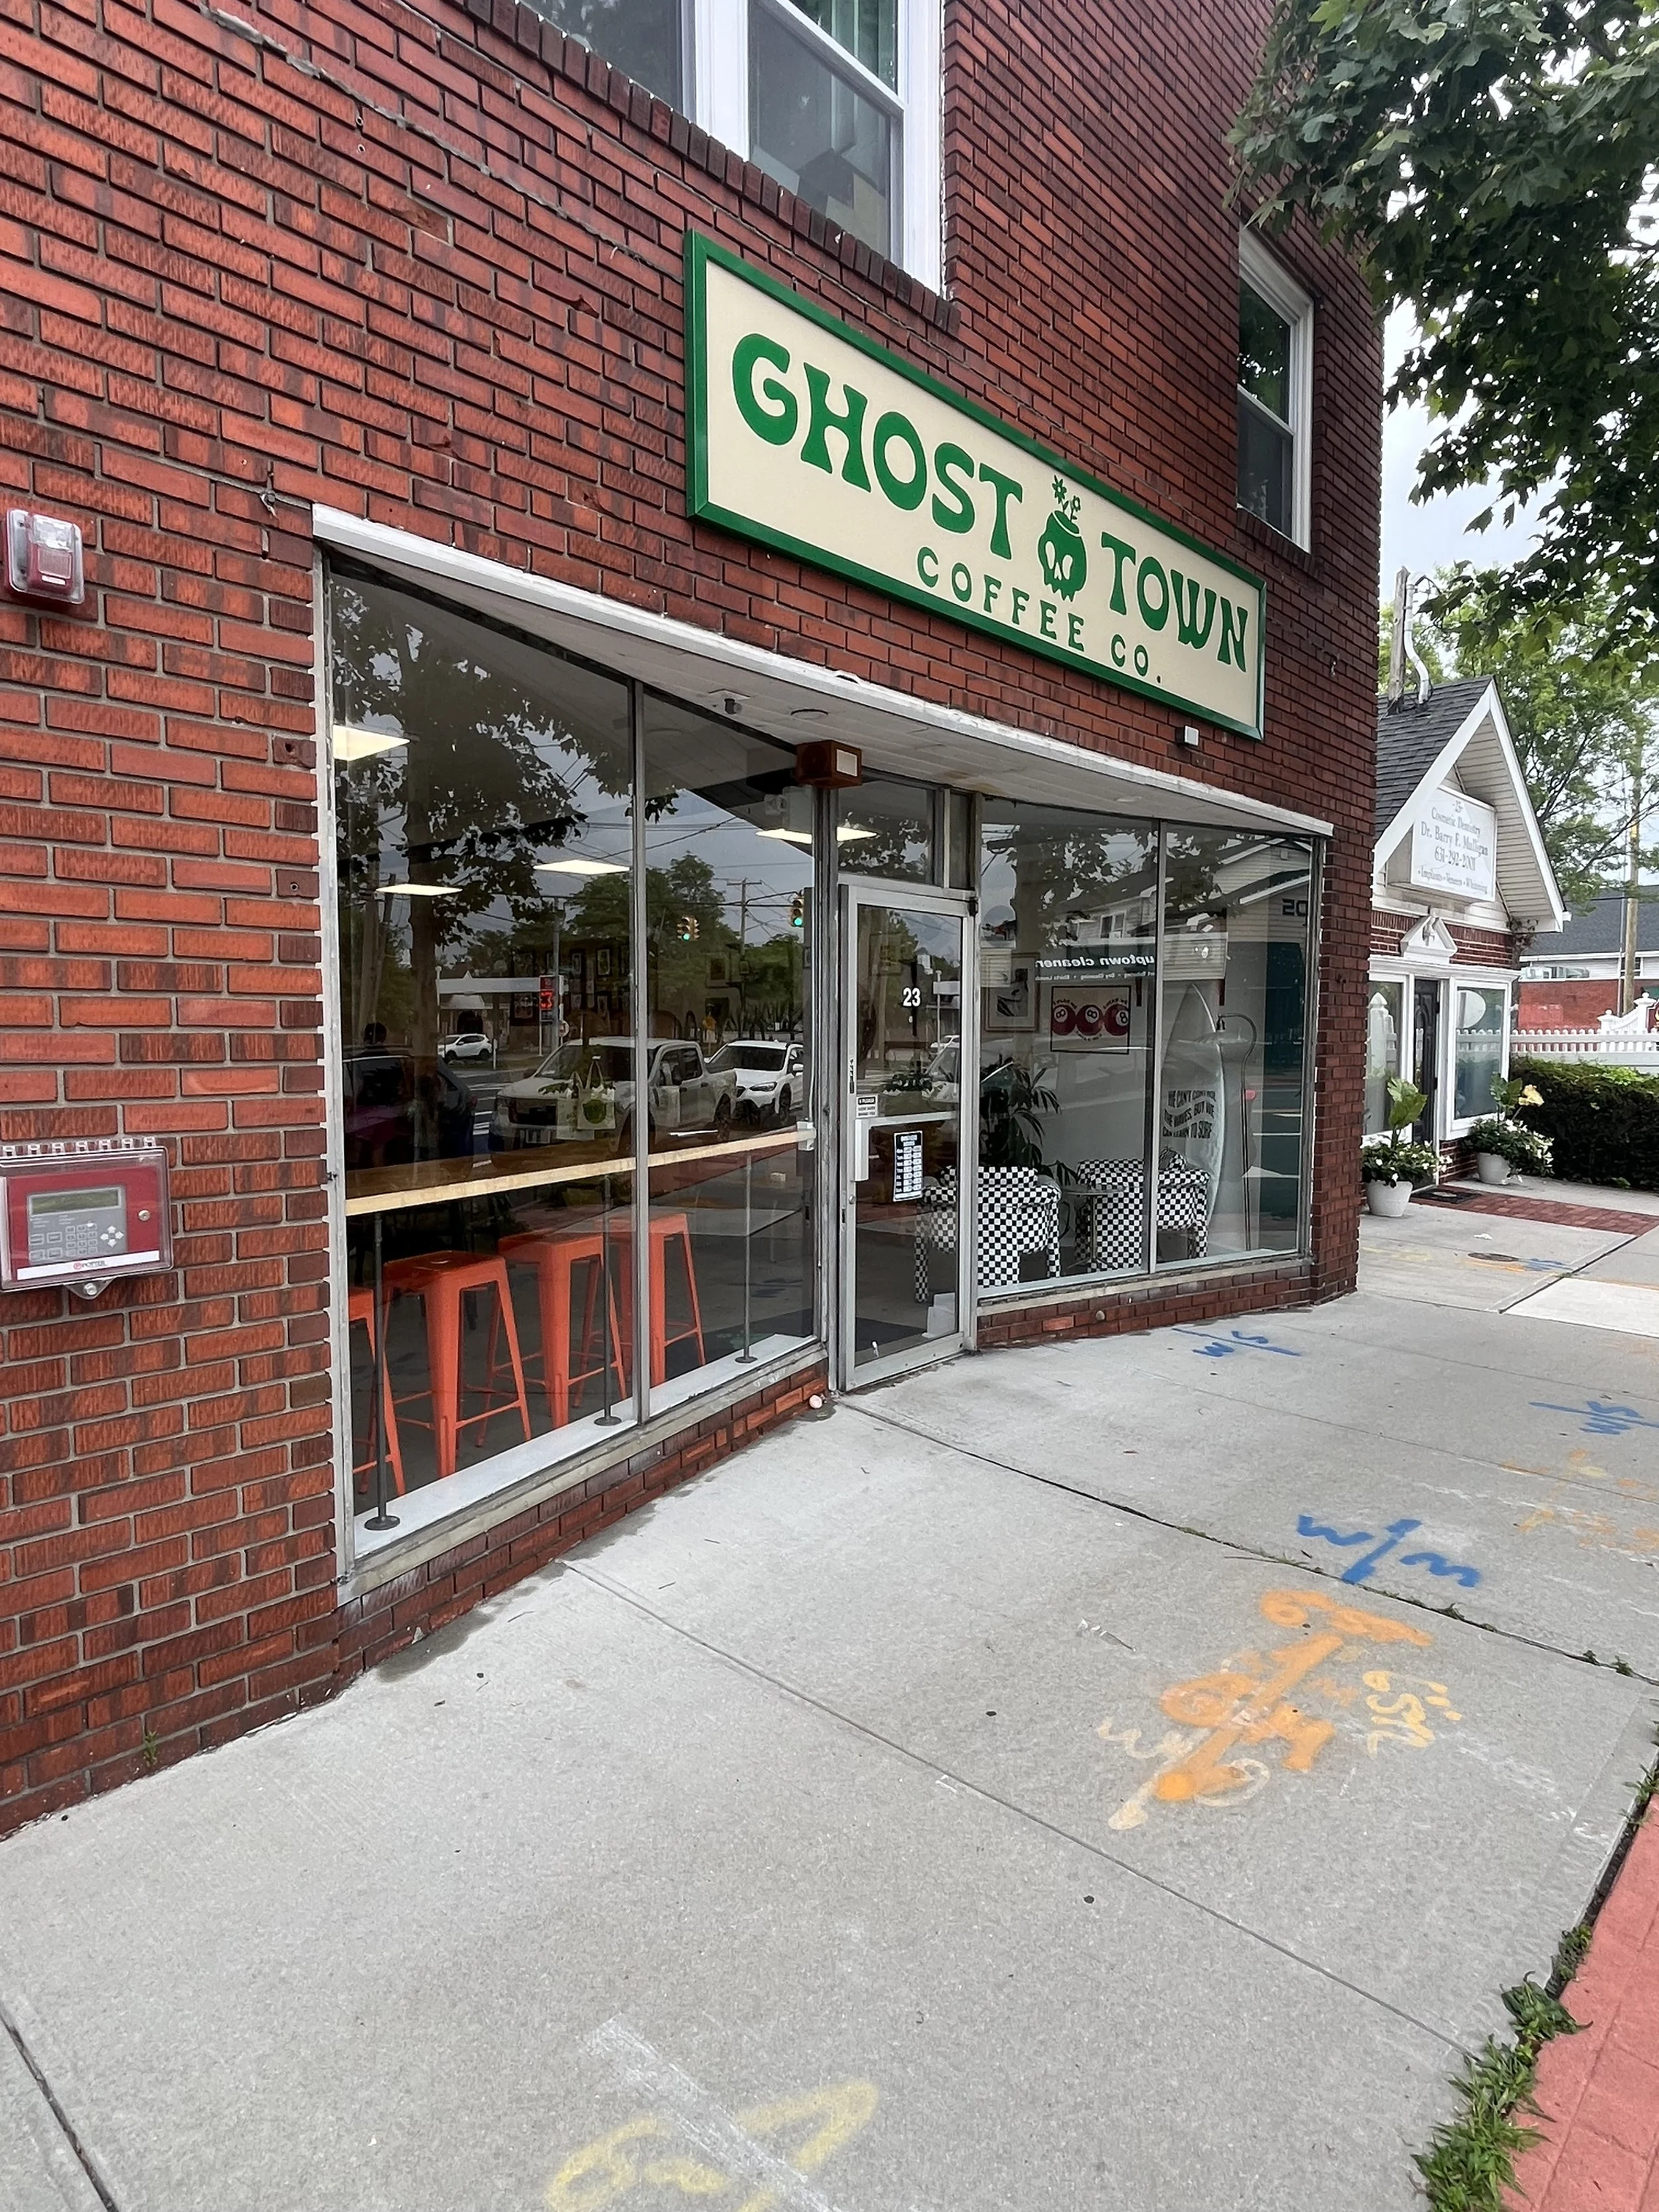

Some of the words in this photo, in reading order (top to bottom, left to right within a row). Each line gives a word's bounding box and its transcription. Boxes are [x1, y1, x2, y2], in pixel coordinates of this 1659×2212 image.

[732, 332, 1023, 559] GHOST
[1101, 530, 1249, 673] TOWN
[917, 547, 1086, 652] COFFEE
[1111, 634, 1163, 684] CO.
[1421, 821, 1433, 838] Dr.
[1435, 826, 1453, 848] Barry
[1431, 807, 1456, 827] Cosmetic
[1457, 816, 1480, 838] Dentistry
[902, 988, 920, 1007] 23
